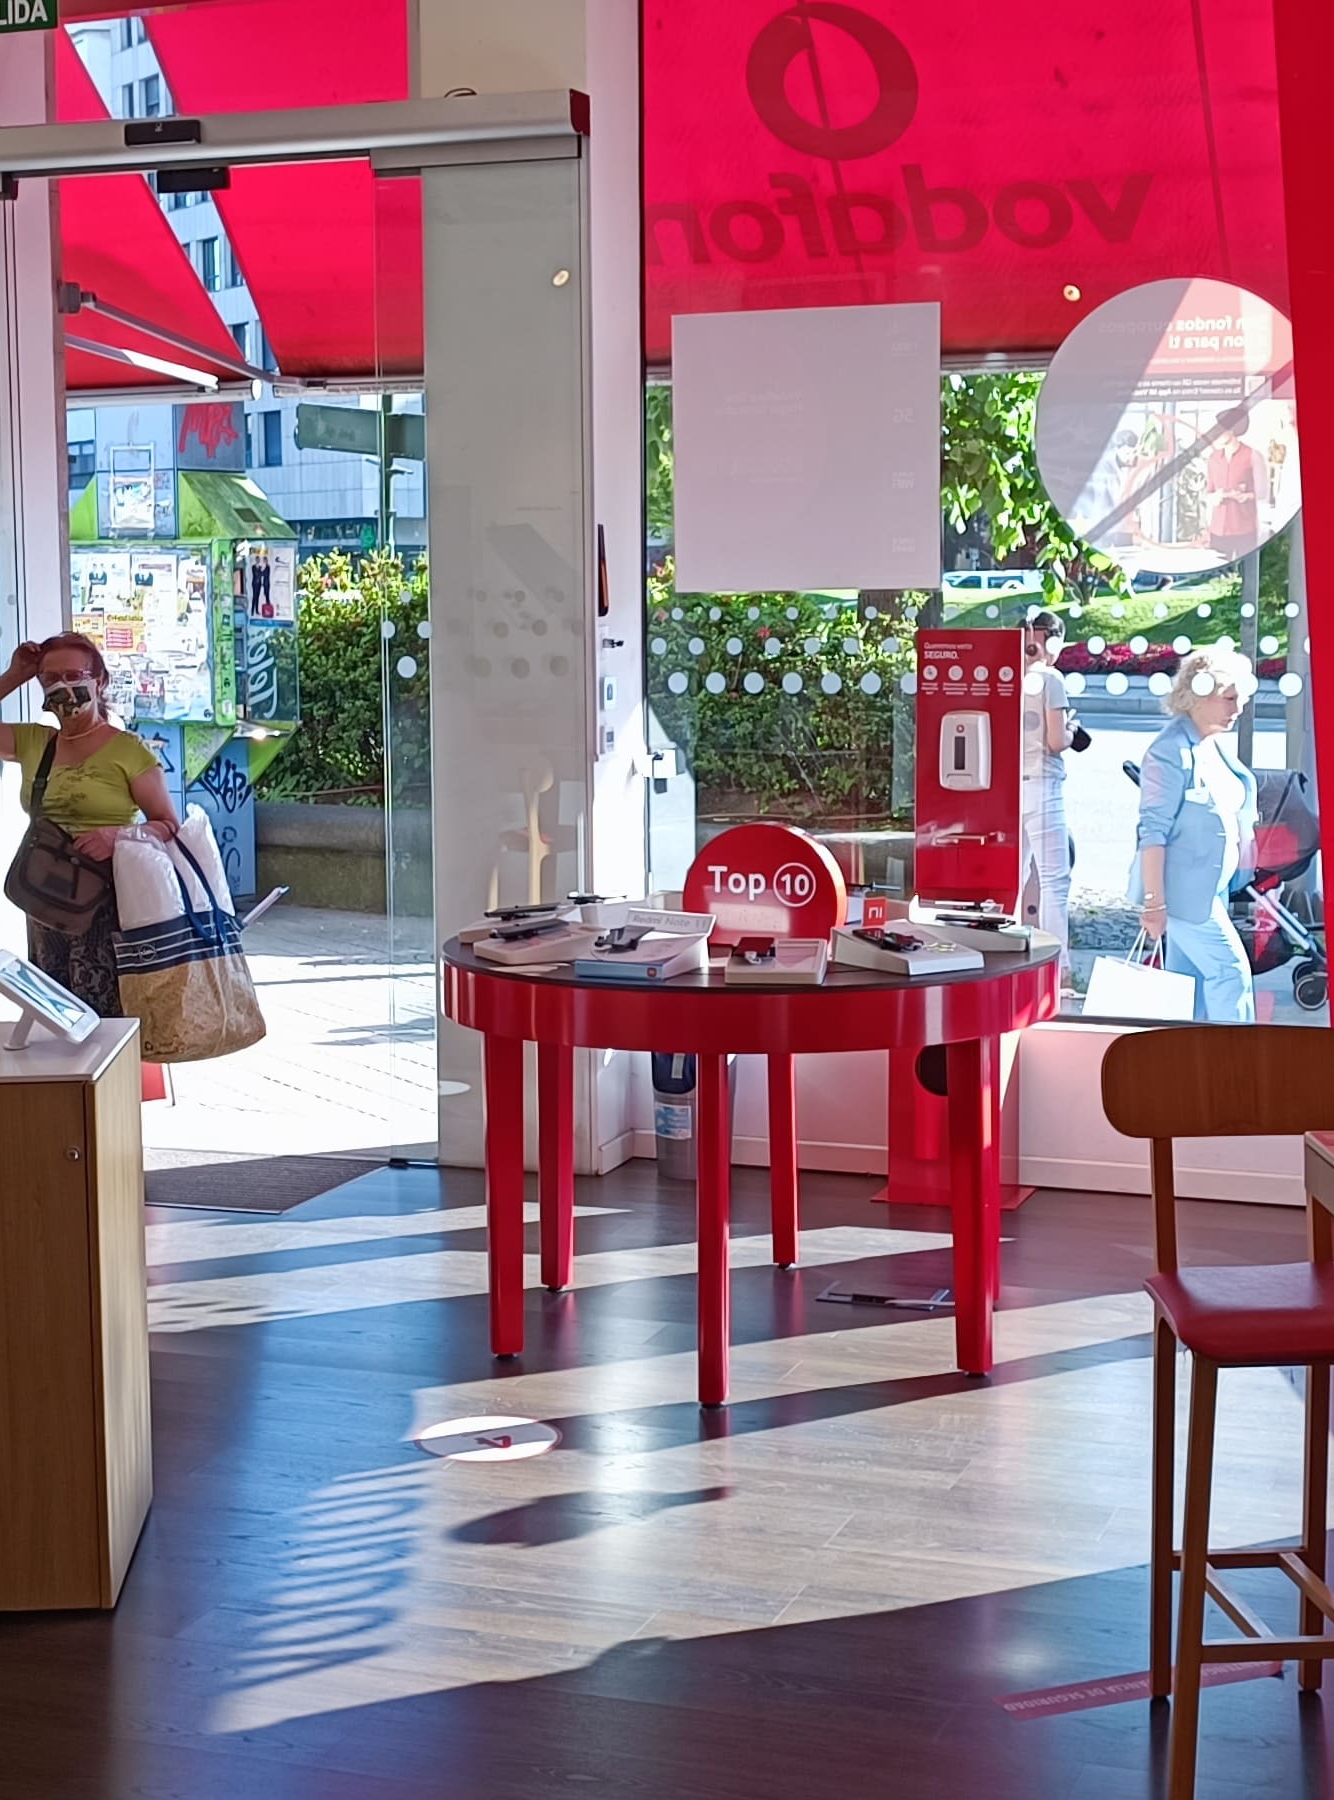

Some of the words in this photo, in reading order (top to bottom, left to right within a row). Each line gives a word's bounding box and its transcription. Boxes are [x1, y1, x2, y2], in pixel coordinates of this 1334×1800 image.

[708, 865, 766, 901] Top
[780, 873, 810, 896] 10
[633, 915, 662, 924] Redmi
[665, 917, 691, 927] Note
